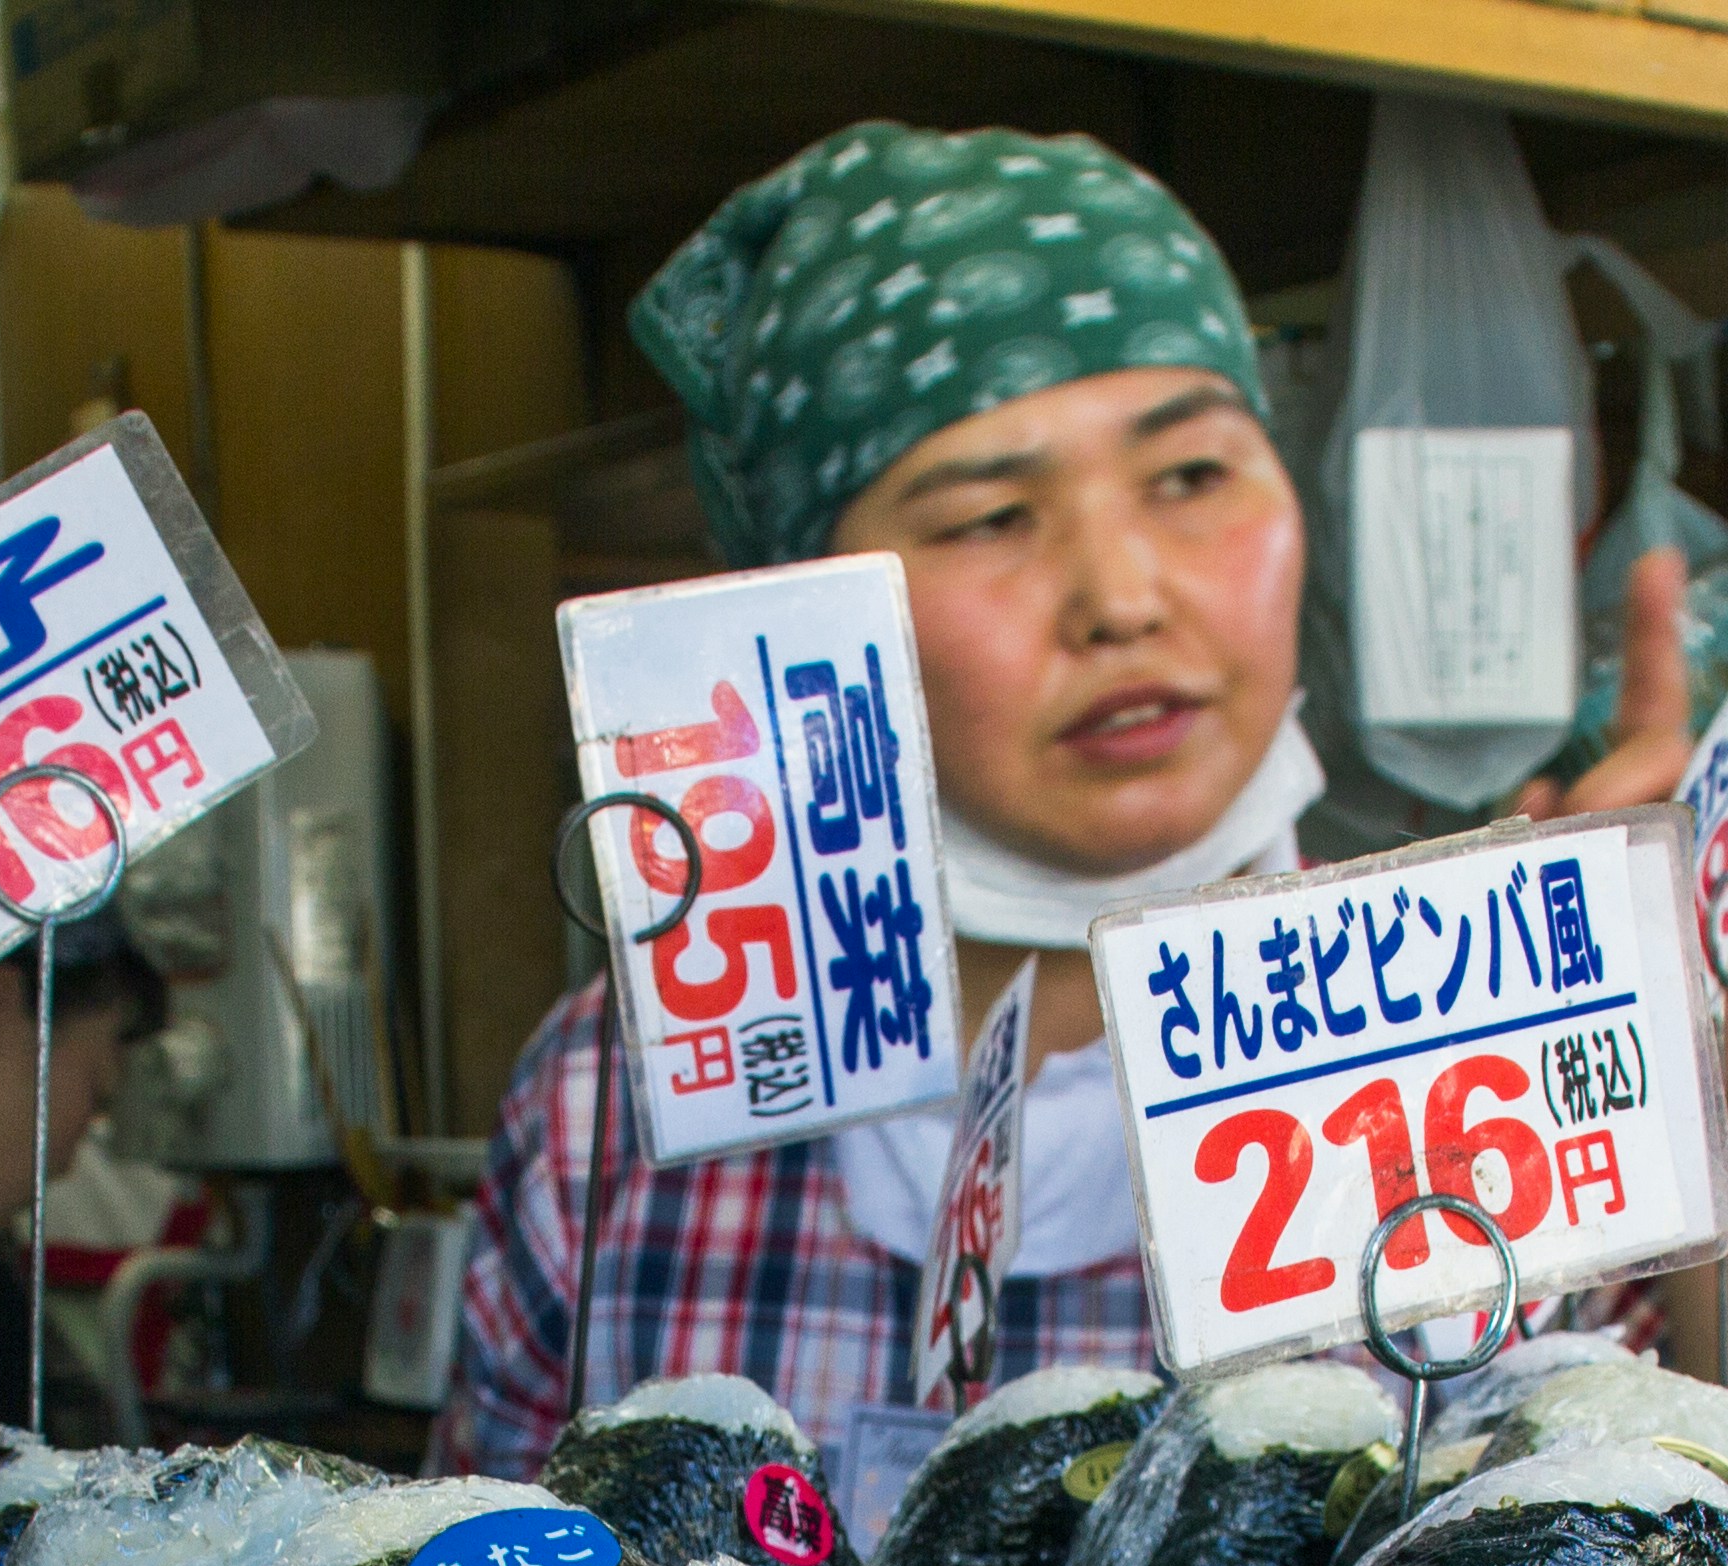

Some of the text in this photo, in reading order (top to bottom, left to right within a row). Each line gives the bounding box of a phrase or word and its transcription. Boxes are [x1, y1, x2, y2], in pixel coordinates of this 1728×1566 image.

[83, 621, 203, 734] (税込)
[782, 641, 933, 1076] 高菜
[1146, 856, 1604, 1082] さんまビビンバ風
[739, 1010, 818, 1120] (税込)
[1193, 1053, 1628, 1315] 216円
[1540, 1021, 1650, 1131] (税込)
